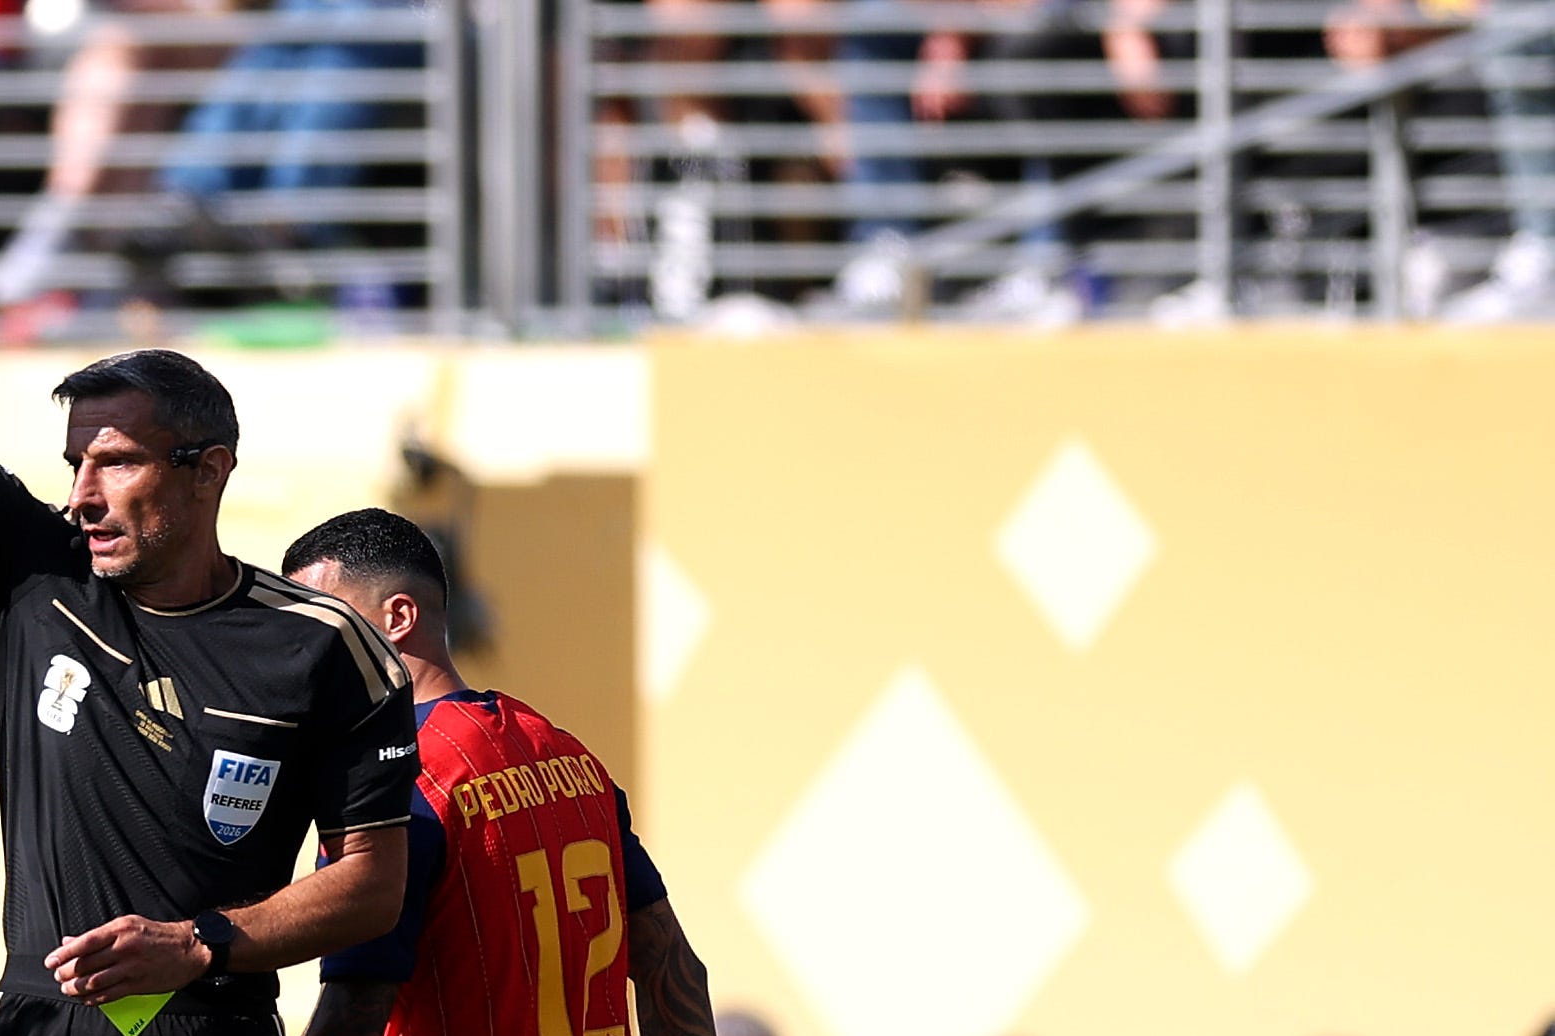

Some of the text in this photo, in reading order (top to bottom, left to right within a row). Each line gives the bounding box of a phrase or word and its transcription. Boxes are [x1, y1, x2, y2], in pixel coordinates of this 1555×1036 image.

[218, 758, 271, 787] FIFA
[211, 793, 263, 811] REFEREE
[452, 764, 545, 829] PEDRO
[217, 824, 242, 837] 2026
[128, 1018, 145, 1035] FIFA
